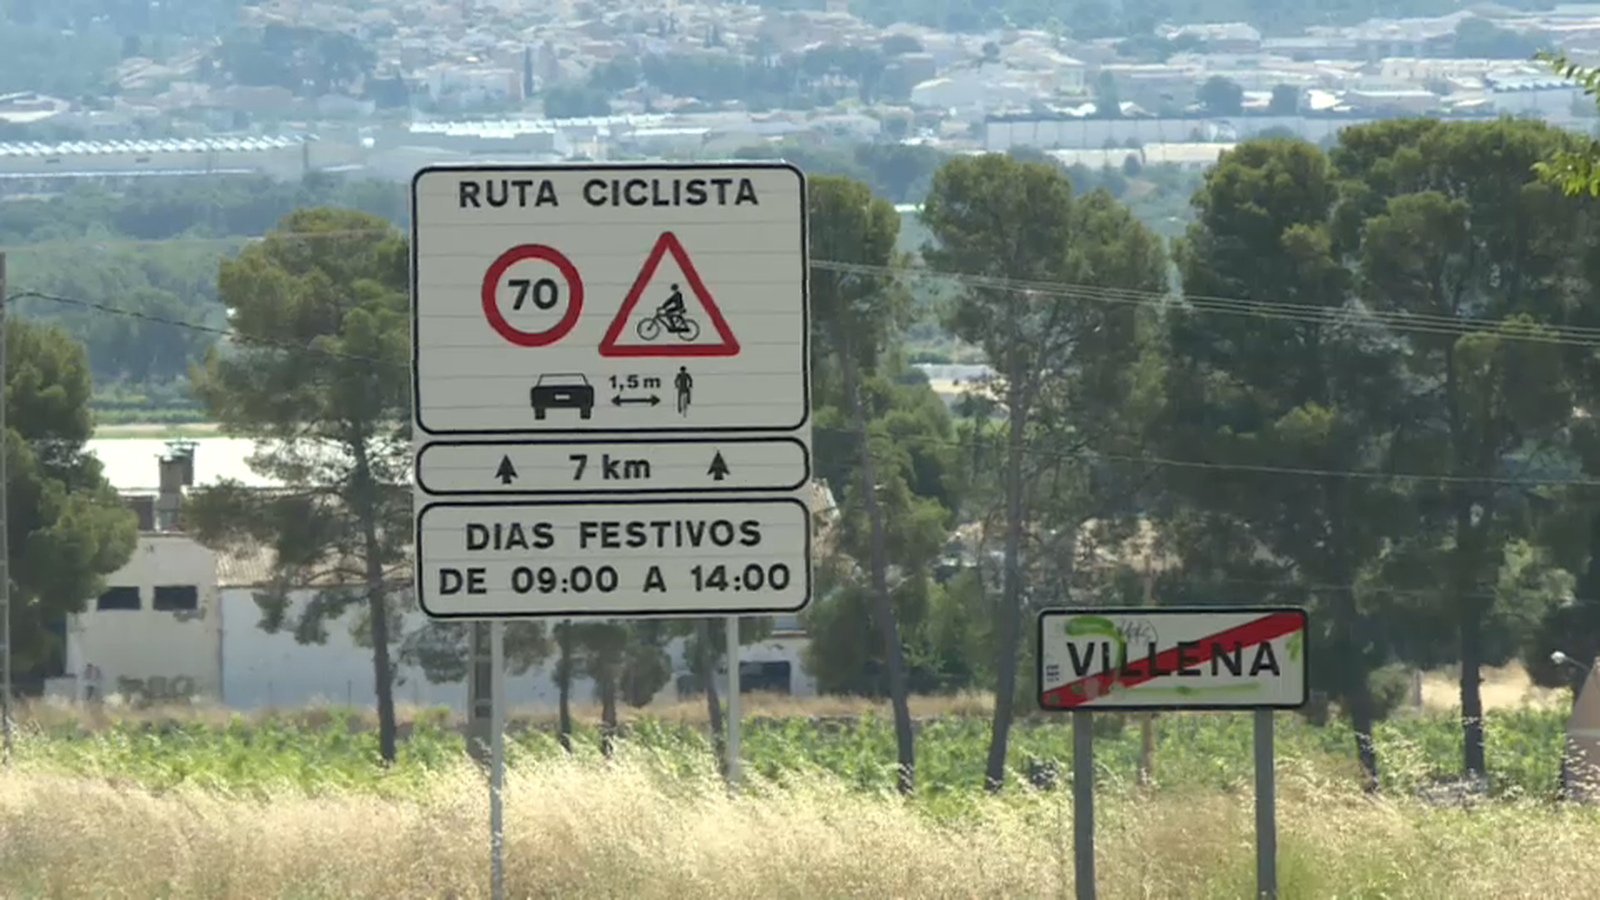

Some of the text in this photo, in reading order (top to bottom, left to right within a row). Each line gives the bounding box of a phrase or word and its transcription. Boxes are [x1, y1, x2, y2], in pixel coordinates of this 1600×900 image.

[459, 178, 758, 208] RUTA CICLISTA
[507, 278, 559, 310] 70
[609, 374, 661, 391] 1,5 m
[569, 453, 651, 481] 7 km
[466, 519, 762, 550] DIAS FESTIVOS
[439, 563, 790, 595] DE 09:00 A 14:00
[1066, 641, 1281, 677] VILLENA
